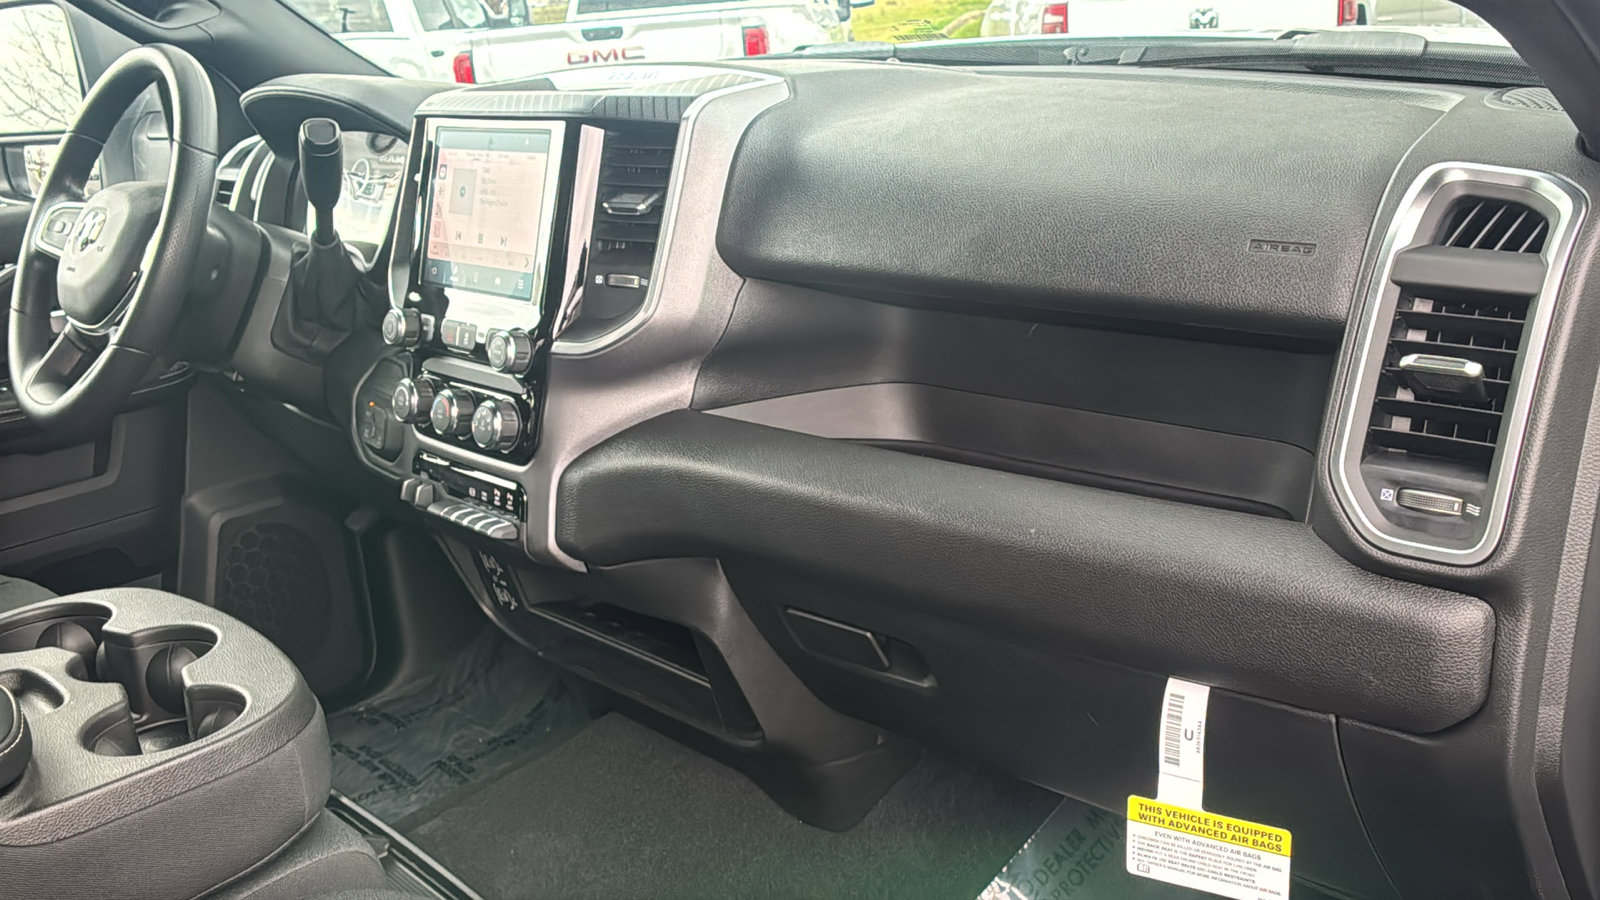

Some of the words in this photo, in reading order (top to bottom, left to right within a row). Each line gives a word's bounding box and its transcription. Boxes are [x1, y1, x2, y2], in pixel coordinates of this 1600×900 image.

[567, 46, 645, 65] GMC
[1253, 242, 1313, 253] AIRBAG
[1138, 802, 1162, 815] THIS
[1165, 808, 1211, 827] VEHICLE
[1213, 820, 1224, 830] IS
[1226, 822, 1283, 843] EQUIPPED
[1138, 812, 1166, 825] WITH
[1168, 817, 1228, 840] ADVANCED
[1230, 834, 1249, 845] AIR
[1252, 838, 1282, 852] BAGS
[1034, 827, 1086, 886] DEALER
[1155, 831, 1171, 839] EVEN
[1174, 835, 1190, 845] WITH
[1192, 840, 1228, 853] ADVANCED
[1230, 848, 1241, 856] AIR
[1243, 851, 1261, 861] BAGS
